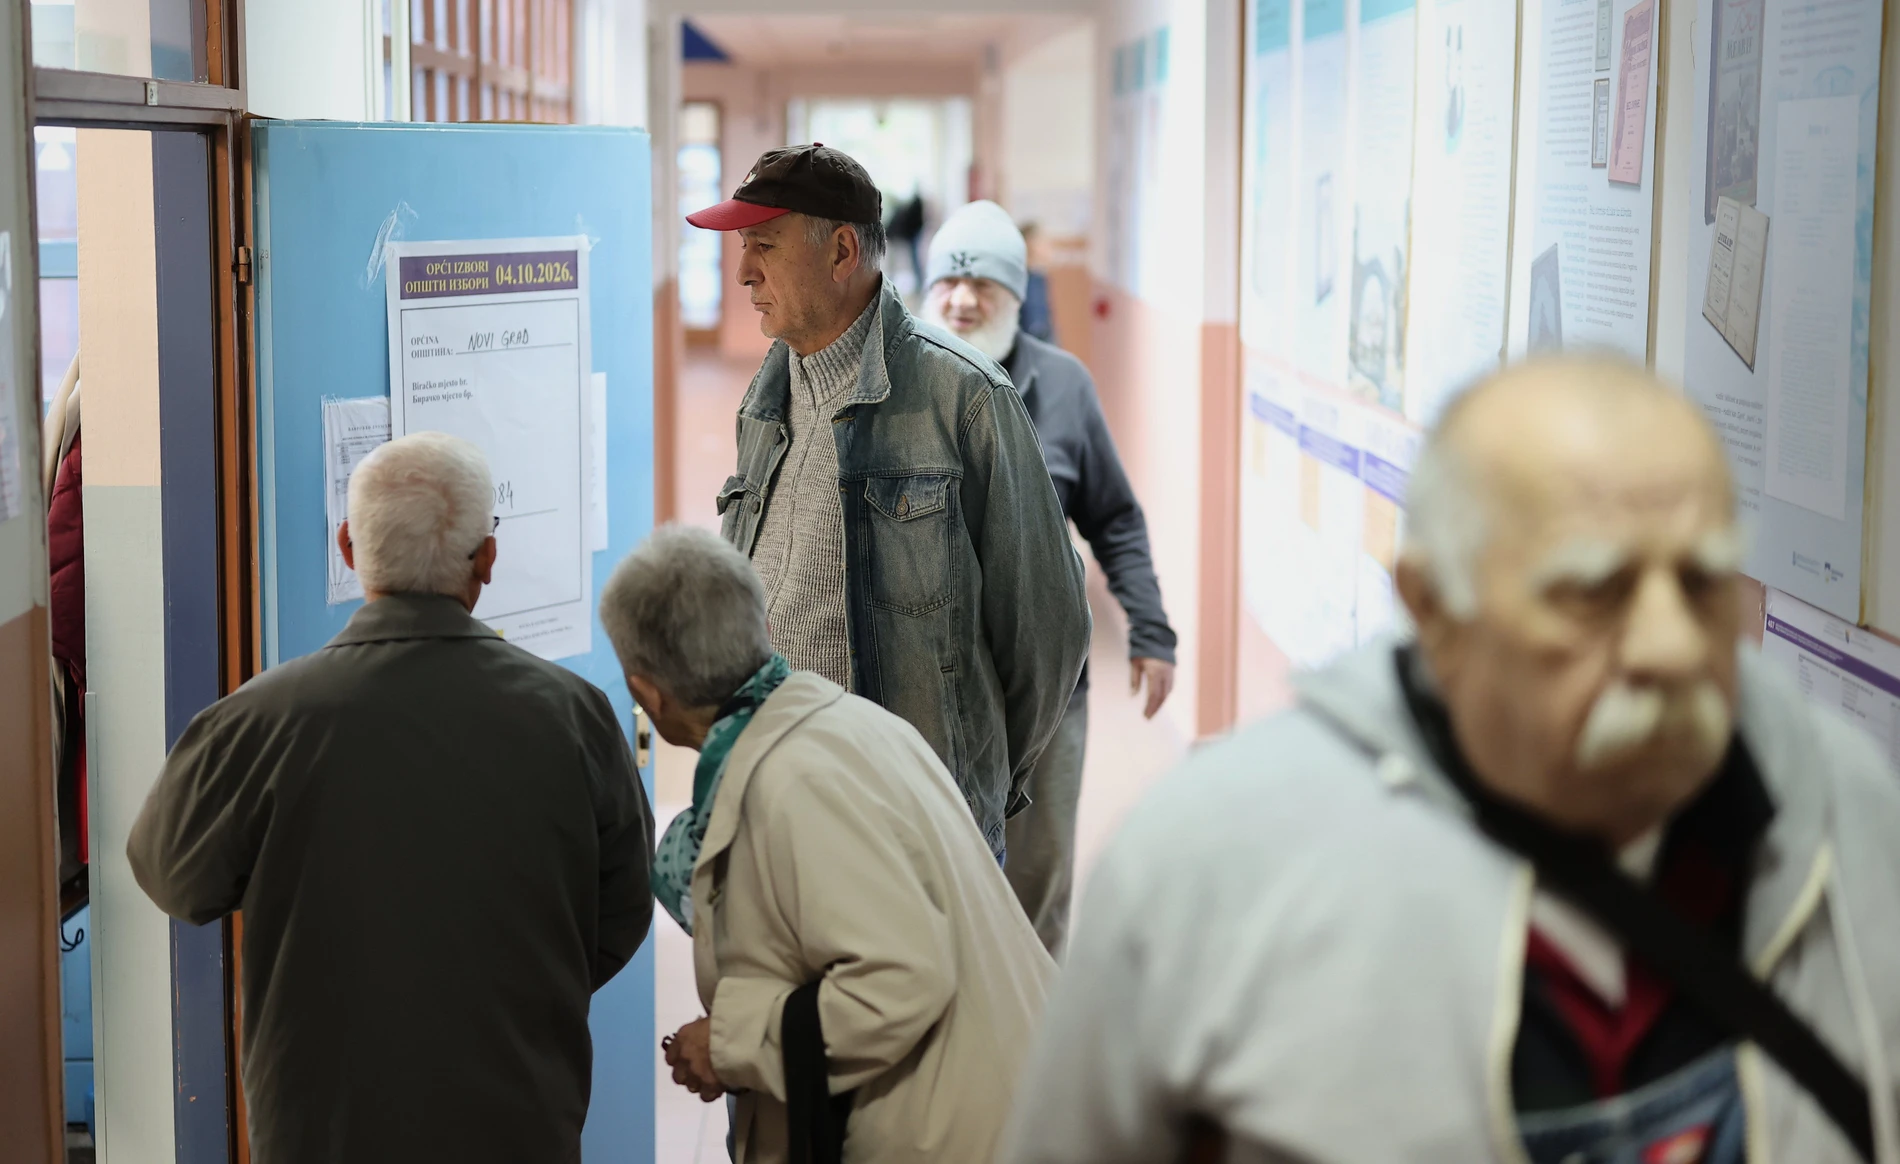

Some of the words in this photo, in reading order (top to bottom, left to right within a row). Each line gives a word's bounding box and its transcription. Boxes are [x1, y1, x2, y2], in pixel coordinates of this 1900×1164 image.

[426, 259, 451, 275] OPĆI
[454, 260, 489, 274] IZBORI
[495, 261, 574, 286] 04.10.2026.
[405, 280, 447, 294] ОПШТИ
[450, 278, 489, 291] ИЗБОРИ
[411, 334, 439, 346] OPĆINA
[468, 332, 494, 351] NOVI
[501, 328, 529, 349] GRAD
[411, 348, 453, 359] ОПШТИНА:
[412, 380, 437, 391] Biračko
[438, 379, 458, 390] mjesto
